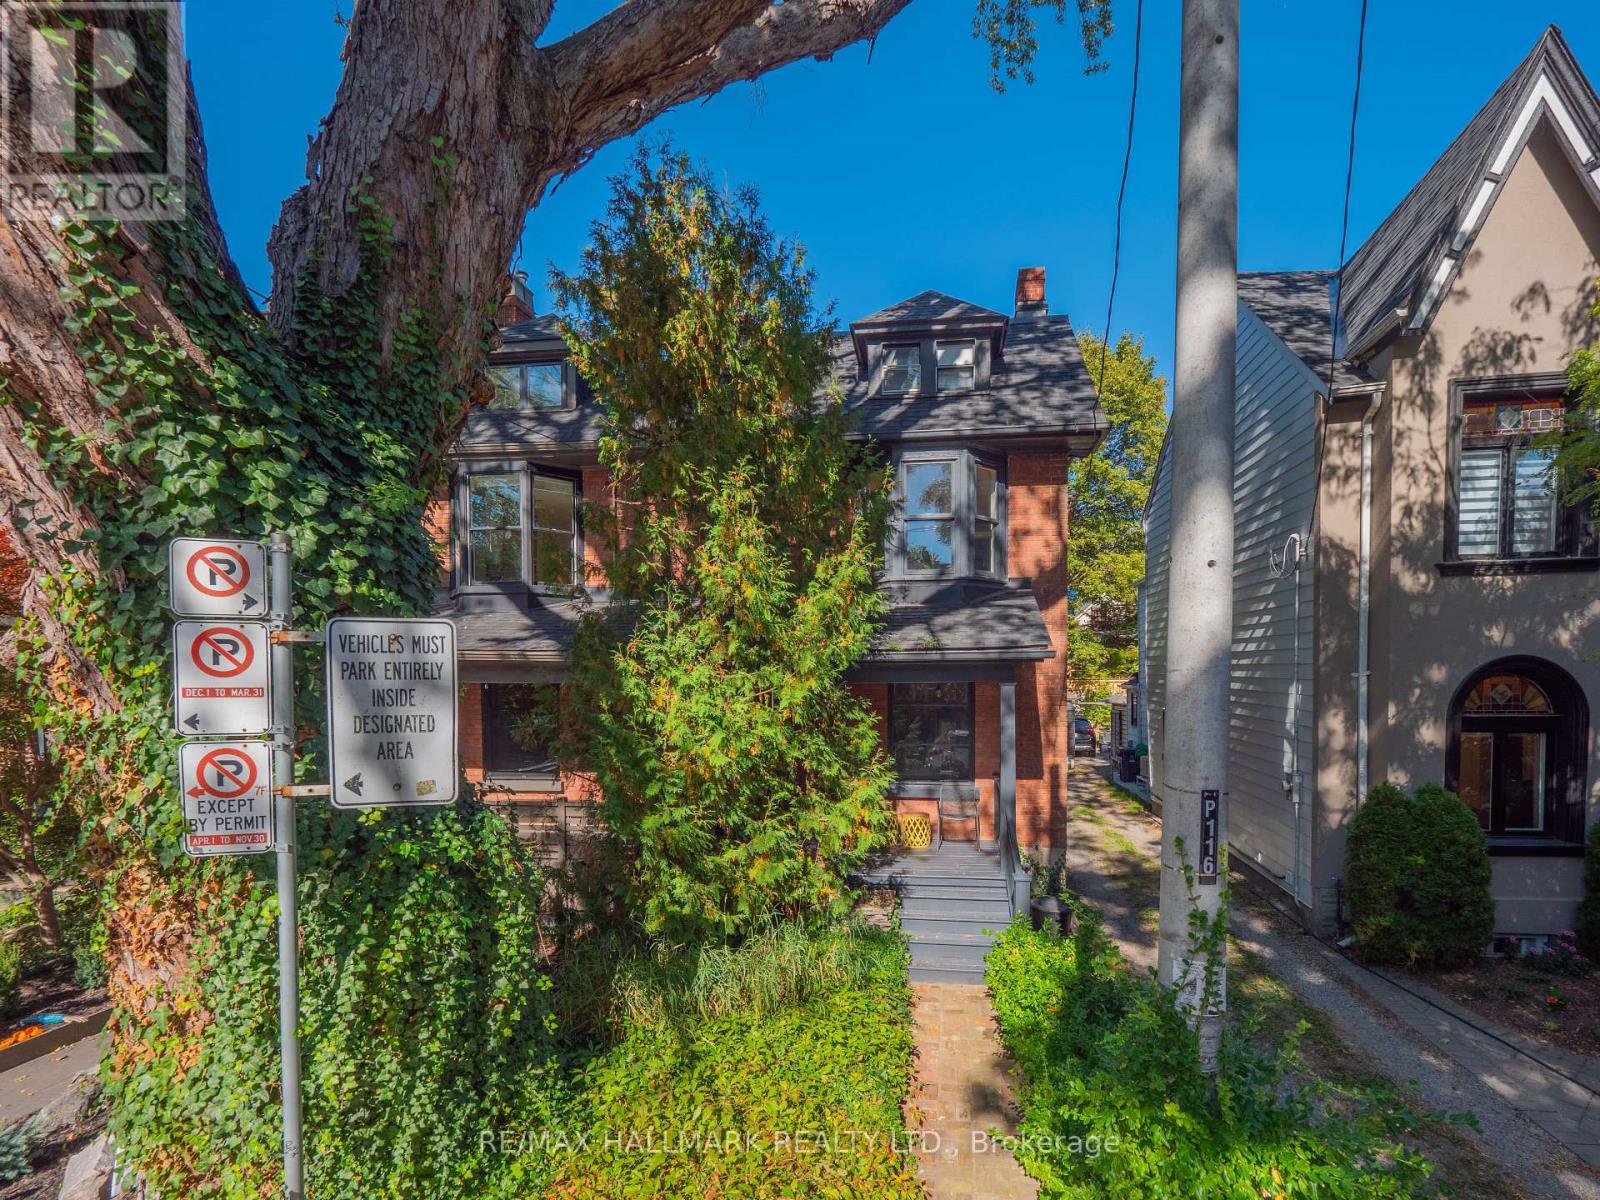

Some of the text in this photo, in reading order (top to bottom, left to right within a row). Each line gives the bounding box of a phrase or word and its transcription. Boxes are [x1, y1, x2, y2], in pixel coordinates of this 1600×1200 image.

[339, 634, 446, 654] VEHICLES MUST
[341, 661, 444, 681] PARK ENTIRELY
[215, 688, 226, 697] TO
[372, 688, 416, 707] INSIDE
[353, 714, 435, 734] DESIGNATED
[376, 741, 415, 760] AREA
[197, 798, 255, 815] EXCEPT
[188, 815, 267, 833] BY PERMIT
[220, 836, 231, 845] TO
[1203, 799, 1216, 874] P116
